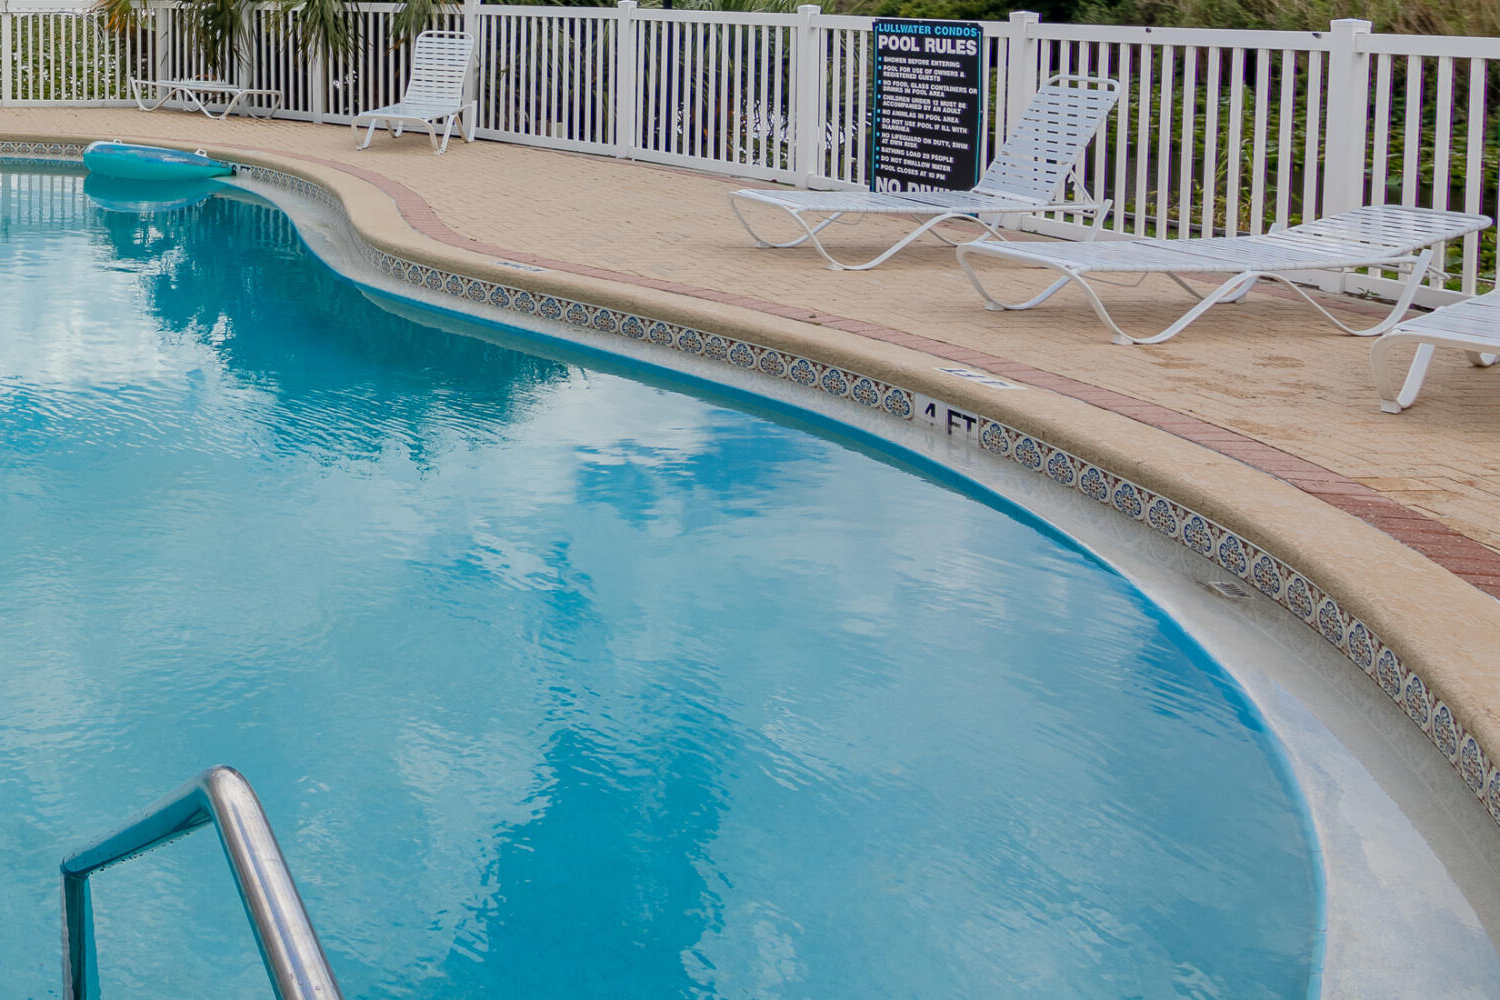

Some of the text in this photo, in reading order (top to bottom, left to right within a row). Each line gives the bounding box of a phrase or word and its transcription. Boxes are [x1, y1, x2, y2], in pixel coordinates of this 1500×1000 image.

[879, 24, 977, 37] LULLWATER CONDOS
[879, 35, 977, 56] POOL RULES
[931, 60, 960, 68] ENTERING
[931, 84, 967, 93] CONTAINERS
[883, 101, 922, 110] ACCOMPANIED
[891, 134, 921, 142] LIFEGUARD
[933, 139, 950, 148] DUTY,
[881, 147, 904, 155] BATHING
[931, 155, 953, 163] PEOPLE
[897, 166, 918, 175] CLOSES
[904, 159, 930, 168] SWALLOW
[932, 163, 950, 172] WATER
[876, 176, 901, 192] NO
[948, 408, 977, 435] FT
